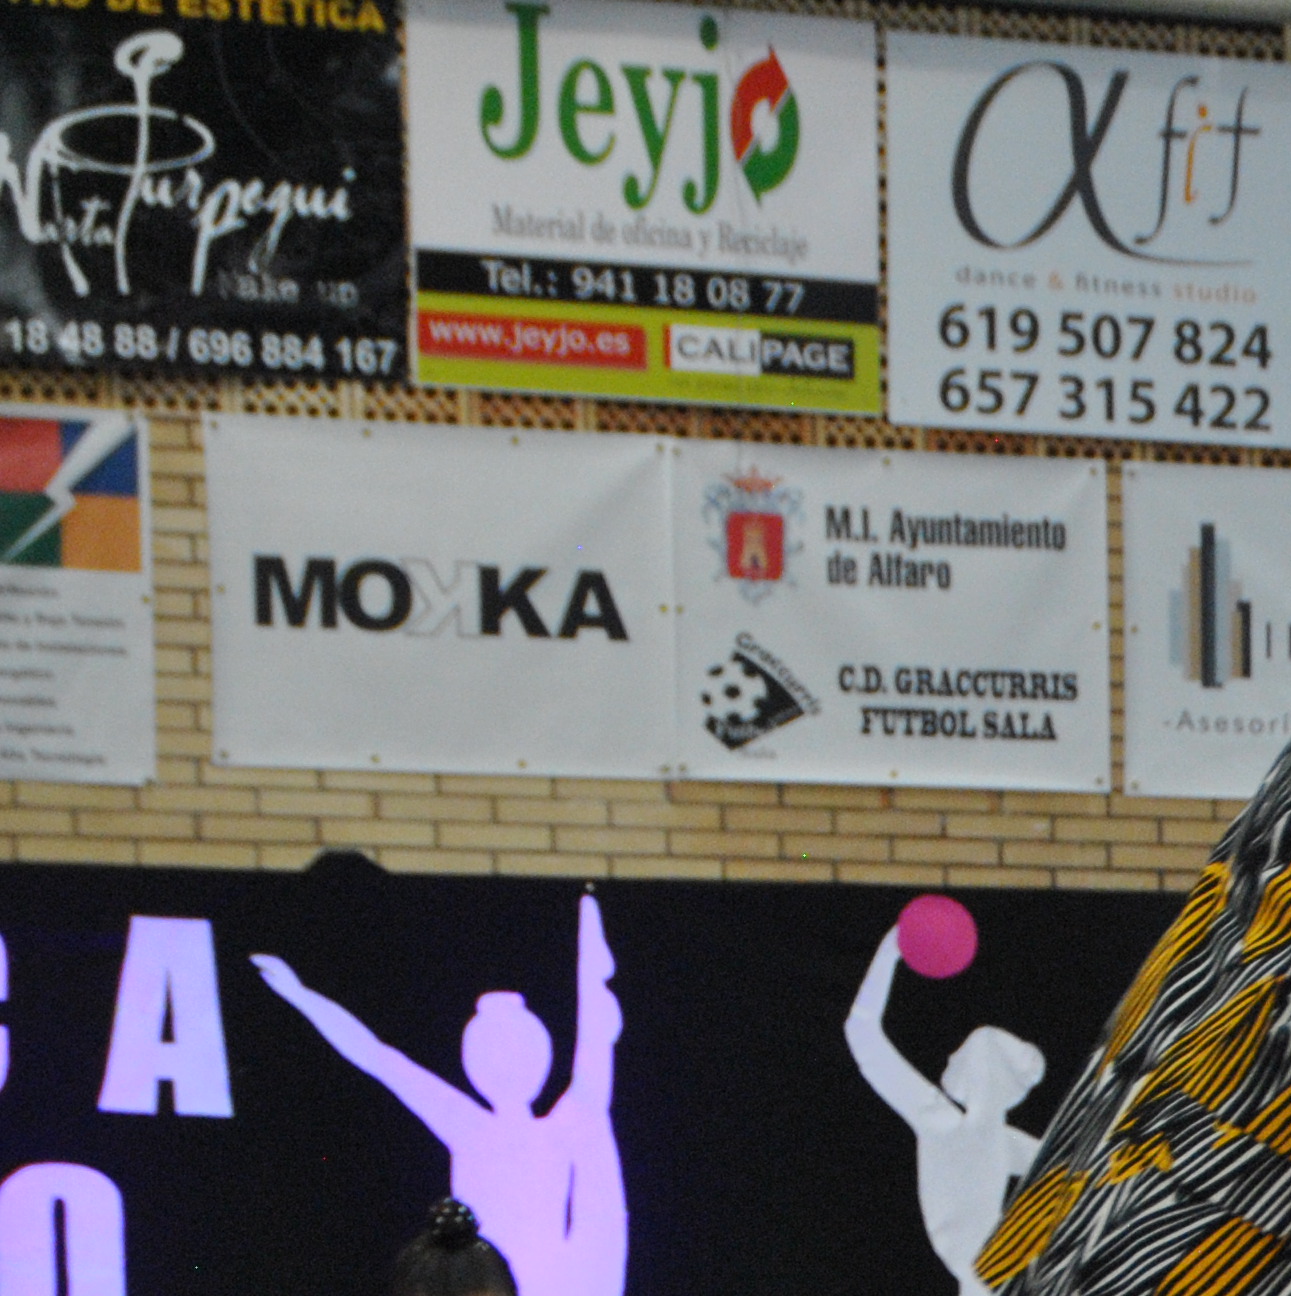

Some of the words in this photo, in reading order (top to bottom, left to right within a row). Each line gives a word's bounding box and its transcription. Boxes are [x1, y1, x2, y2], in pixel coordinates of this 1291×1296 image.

[491, 203, 585, 242] Material
[591, 212, 615, 243] de
[622, 214, 691, 250] oficina
[696, 228, 710, 257] y
[717, 221, 807, 266] Reciclaje
[480, 257, 557, 297] Tel.:
[572, 266, 637, 301] 941
[654, 271, 695, 306] 18
[707, 276, 750, 310] 08
[762, 281, 804, 315] 77
[955, 265, 1036, 289] dance
[1047, 271, 1064, 291] &
[1074, 274, 1162, 298] fitness
[1172, 279, 1257, 304] studio
[5, 317, 49, 355] 18
[57, 318, 103, 358] 48
[114, 322, 158, 360] 88
[188, 326, 253, 366] 696
[261, 331, 325, 371] 884
[336, 336, 398, 375] 167
[429, 318, 630, 355] www.jeyjo.es
[938, 303, 1040, 352] 619
[1057, 311, 1155, 361] 507
[1174, 319, 1272, 369] 824
[939, 367, 1039, 416] 657
[1059, 375, 1156, 424] 315
[1174, 383, 1271, 431] 422
[825, 504, 878, 542] M.I.
[889, 506, 1066, 550] Ayuntamiento
[827, 550, 856, 585] de
[868, 552, 951, 590] Alfaro
[839, 664, 888, 694] C.D.
[894, 665, 1078, 702] GRACCURRIS
[861, 705, 976, 739] FUTBOL
[982, 709, 1057, 741] SALA
